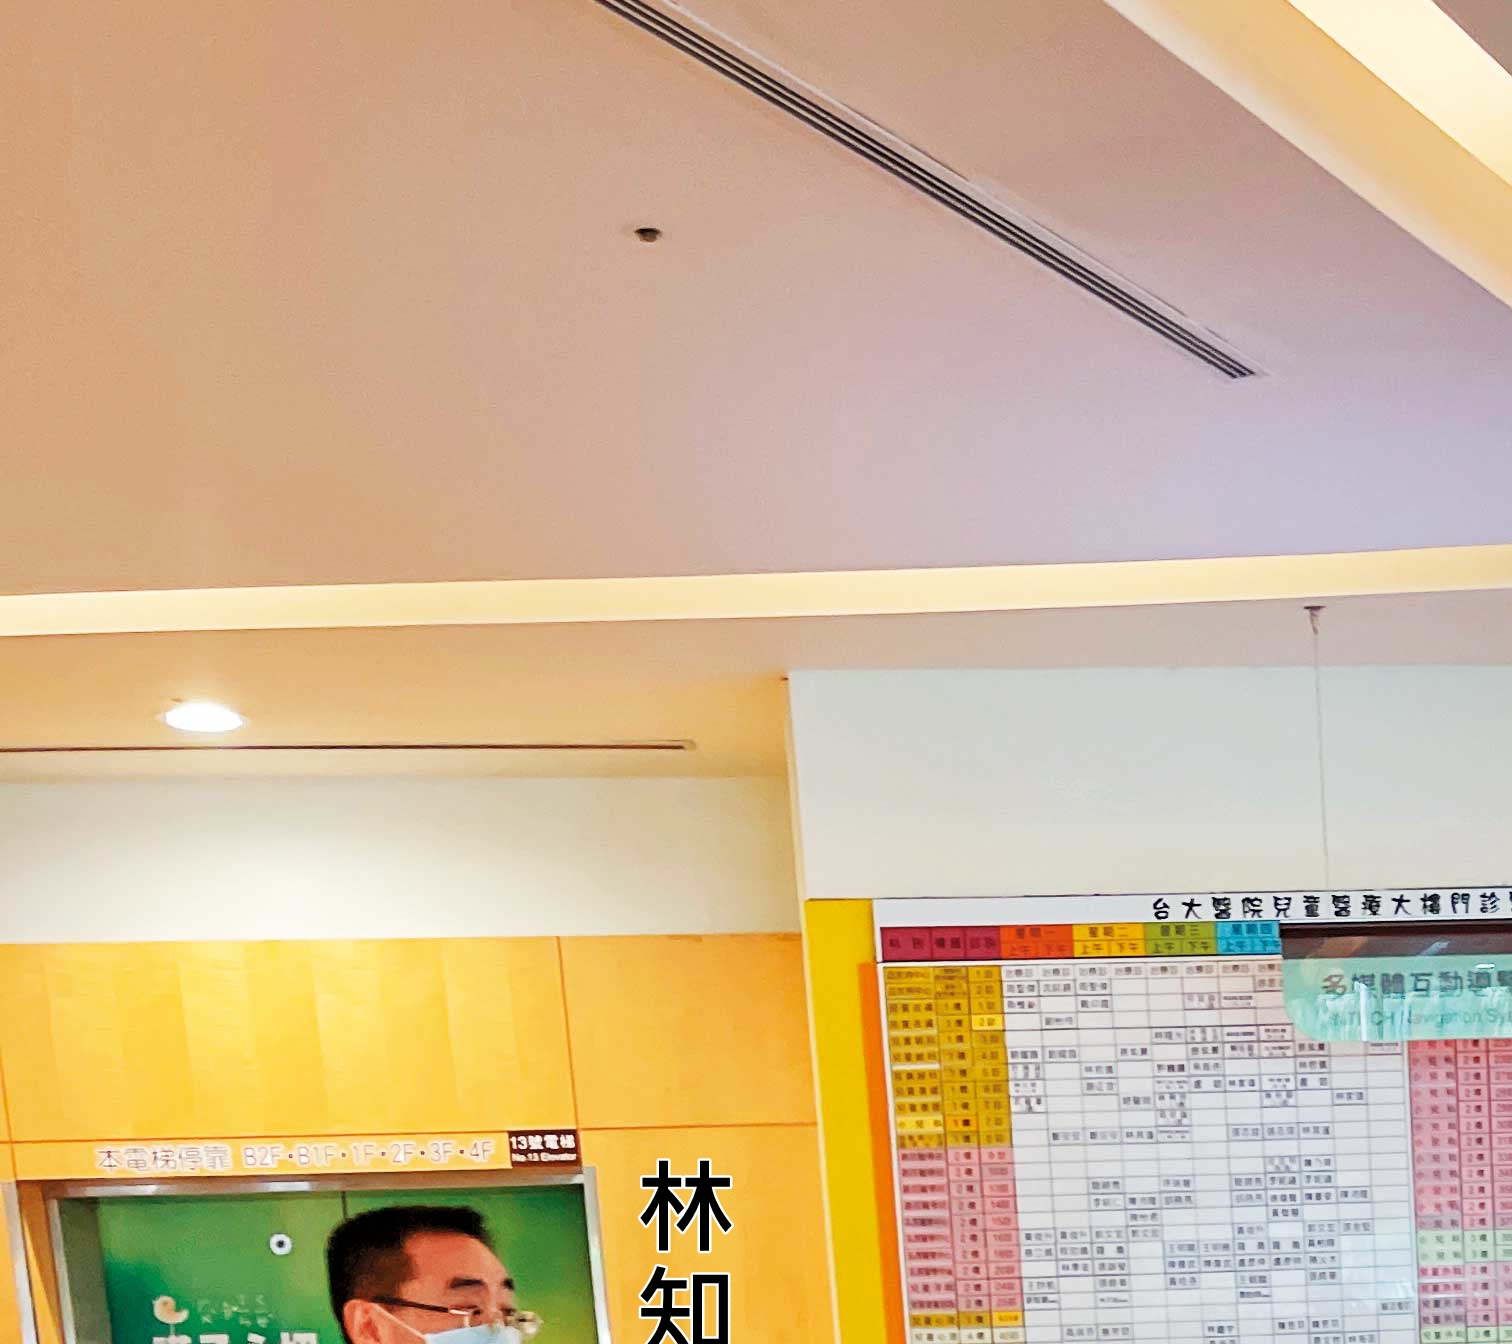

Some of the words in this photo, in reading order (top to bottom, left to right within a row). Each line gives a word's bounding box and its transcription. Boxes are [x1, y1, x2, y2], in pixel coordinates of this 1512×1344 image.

[510, 1134, 576, 1150] 13號電梯
[95, 1144, 232, 1172] 本電梯停靠
